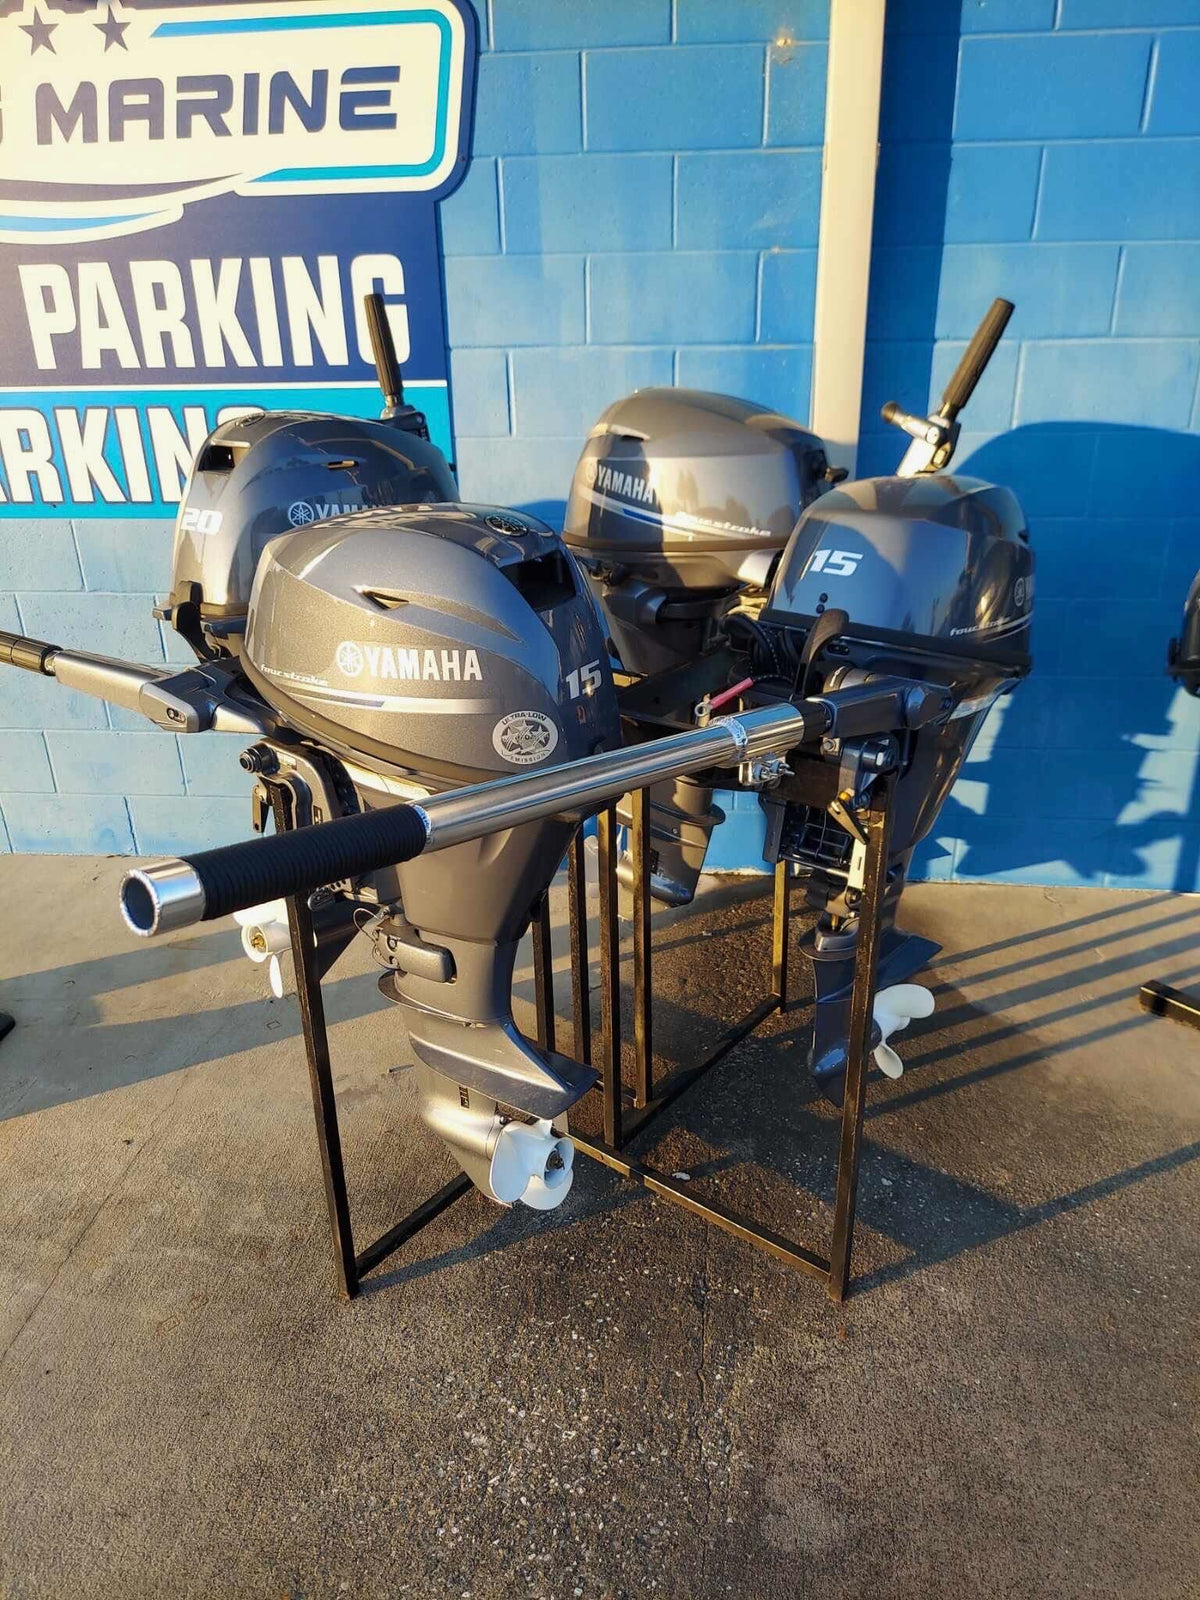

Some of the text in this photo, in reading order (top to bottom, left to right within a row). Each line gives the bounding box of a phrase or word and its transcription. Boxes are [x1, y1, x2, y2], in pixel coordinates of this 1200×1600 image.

[35, 65, 401, 146] MARINE
[18, 254, 411, 370] PARKING
[0, 406, 265, 504] RKIN
[597, 464, 654, 504] YAMAHA
[180, 507, 223, 536] 20
[809, 549, 864, 577] 15
[364, 646, 483, 681] YAMAHA
[565, 659, 602, 700] 15
